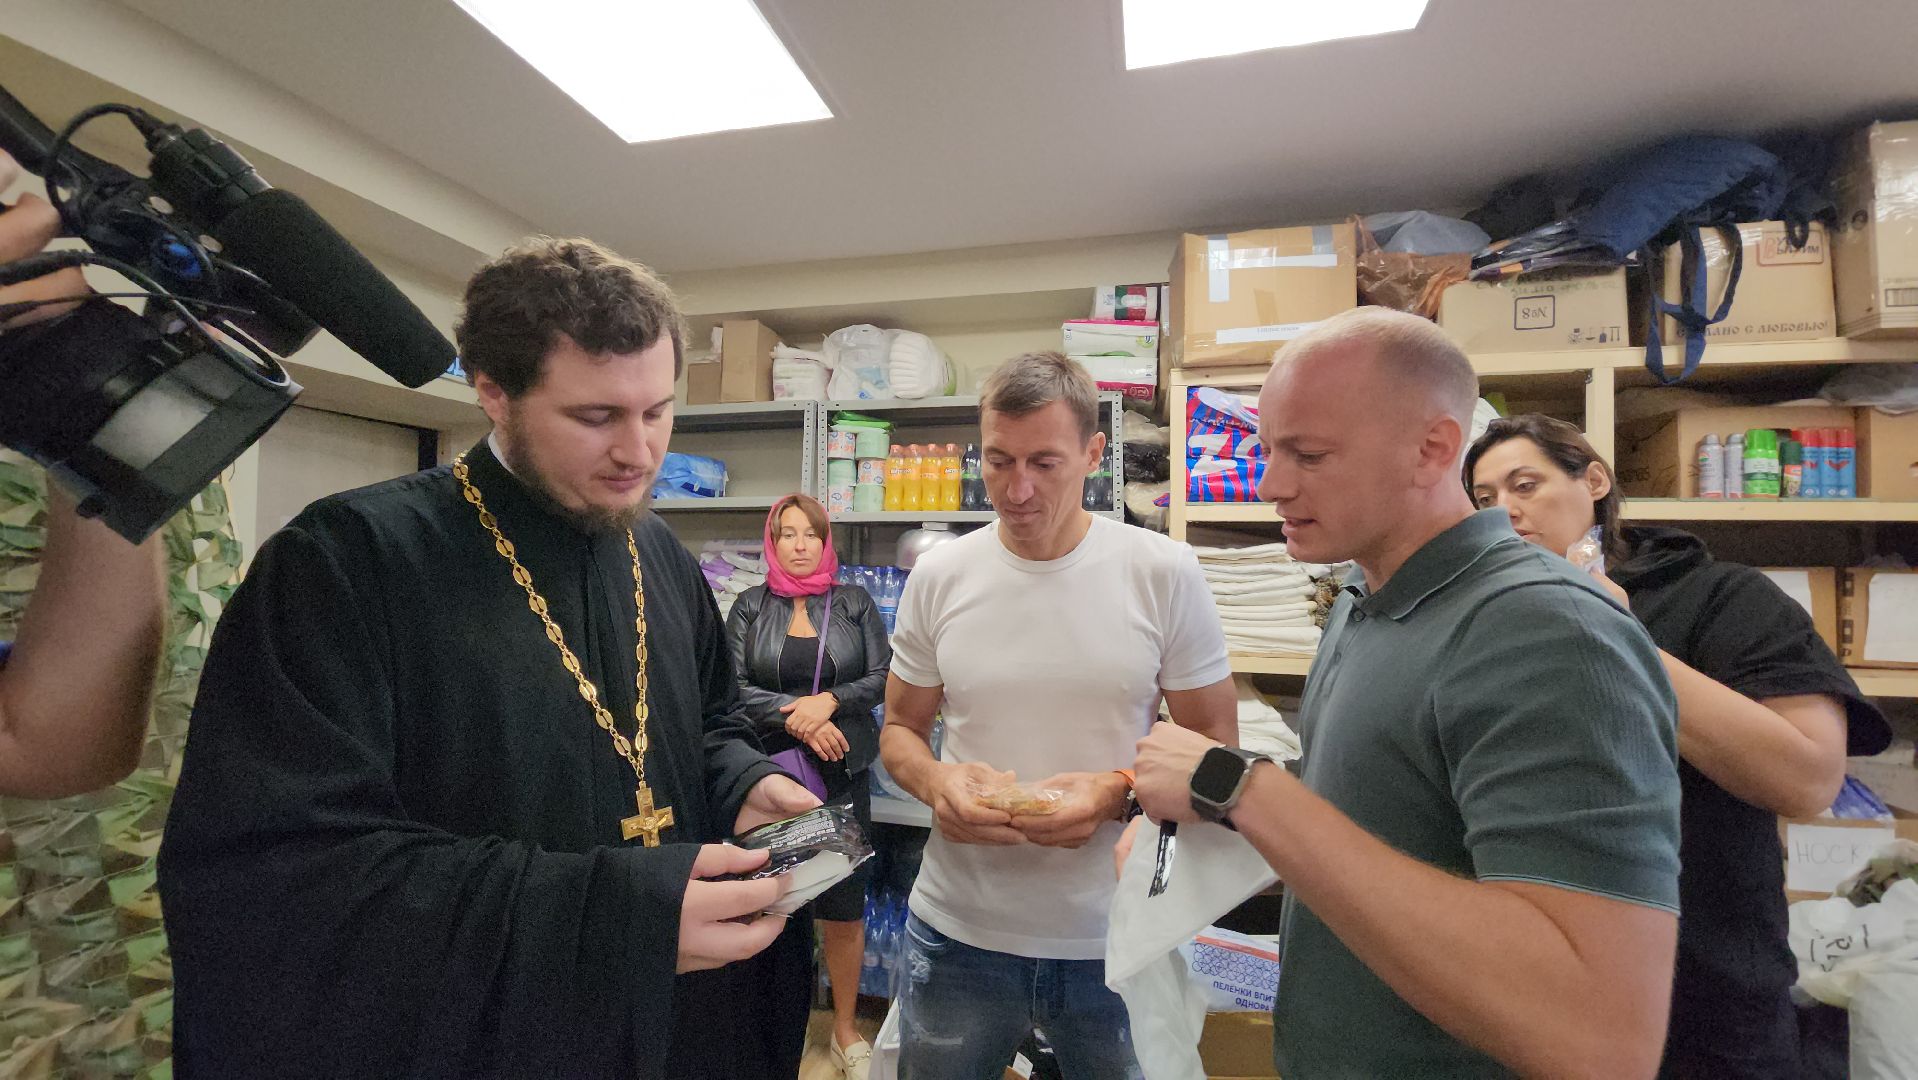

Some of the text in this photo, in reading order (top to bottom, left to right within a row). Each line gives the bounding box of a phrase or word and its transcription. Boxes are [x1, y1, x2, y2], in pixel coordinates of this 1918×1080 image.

[1795, 841, 1871, 865] НОСК
[1213, 980, 1252, 997] ПЕЛЕНКИ
[1235, 997, 1274, 1011] ОДНОРА
